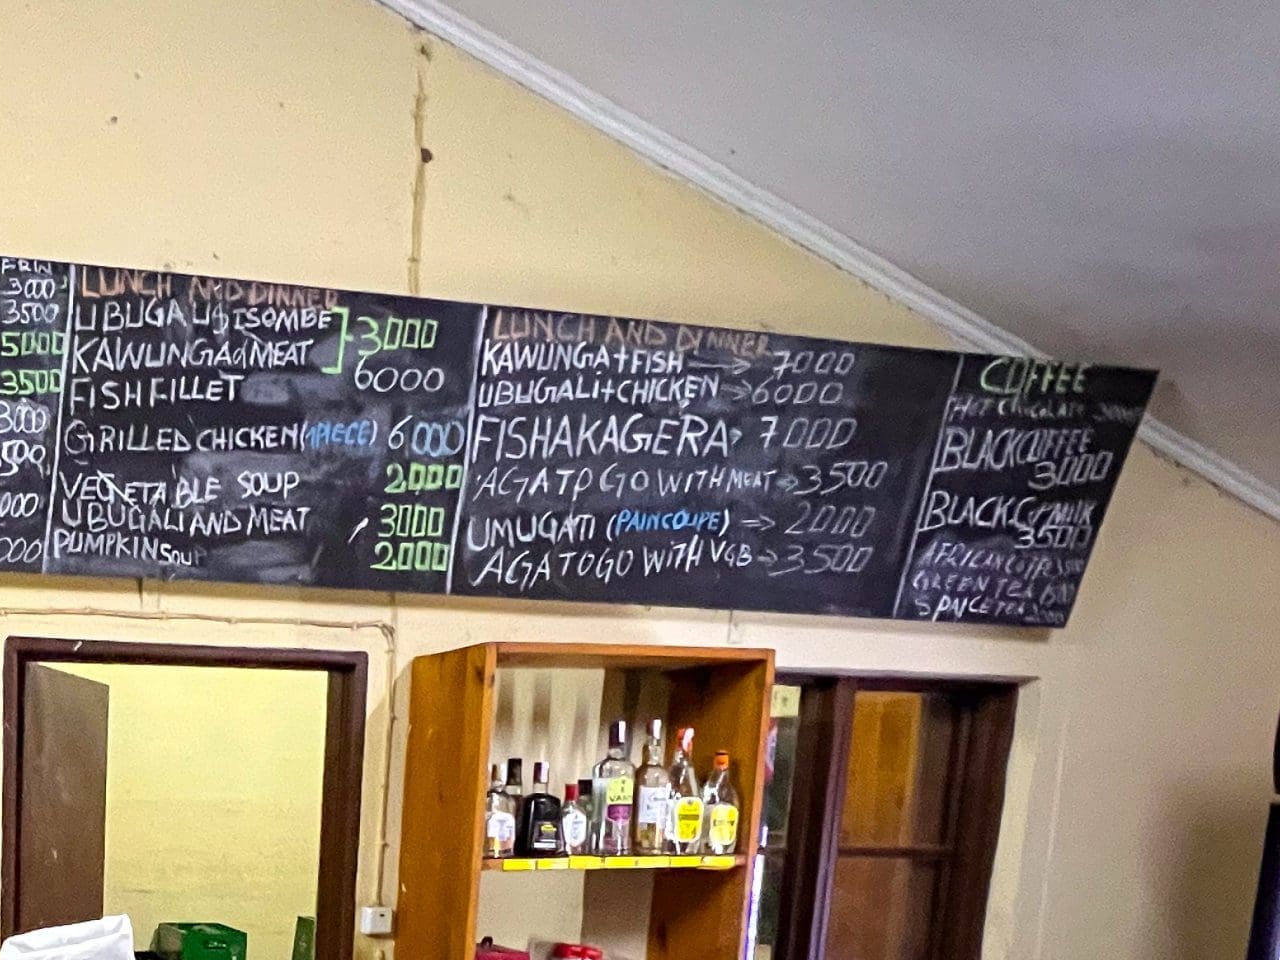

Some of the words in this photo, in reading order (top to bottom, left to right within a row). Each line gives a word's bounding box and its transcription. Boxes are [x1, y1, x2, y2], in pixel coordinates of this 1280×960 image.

[0, 278, 56, 300] 3000
[1, 300, 60, 324] 3500
[493, 309, 595, 343] LUNCH
[604, 320, 668, 347] AND
[0, 331, 67, 357] 5000
[357, 315, 439, 356] 3000
[773, 349, 855, 380] 7000
[70, 377, 142, 416] FISH
[150, 373, 245, 409] FILLET
[354, 355, 446, 393] 6000
[751, 374, 844, 405] 6000
[64, 418, 192, 455] GRILLED
[759, 414, 858, 450] 7000
[237, 470, 300, 499] SOUP
[384, 462, 464, 494] 2000
[793, 460, 889, 496] 3500
[1028, 451, 1113, 489] 3000
[246, 505, 311, 536] MEAT
[377, 503, 446, 538] 3000
[784, 500, 877, 538] 2000
[370, 541, 452, 572] 2000
[768, 543, 875, 577] 3500
